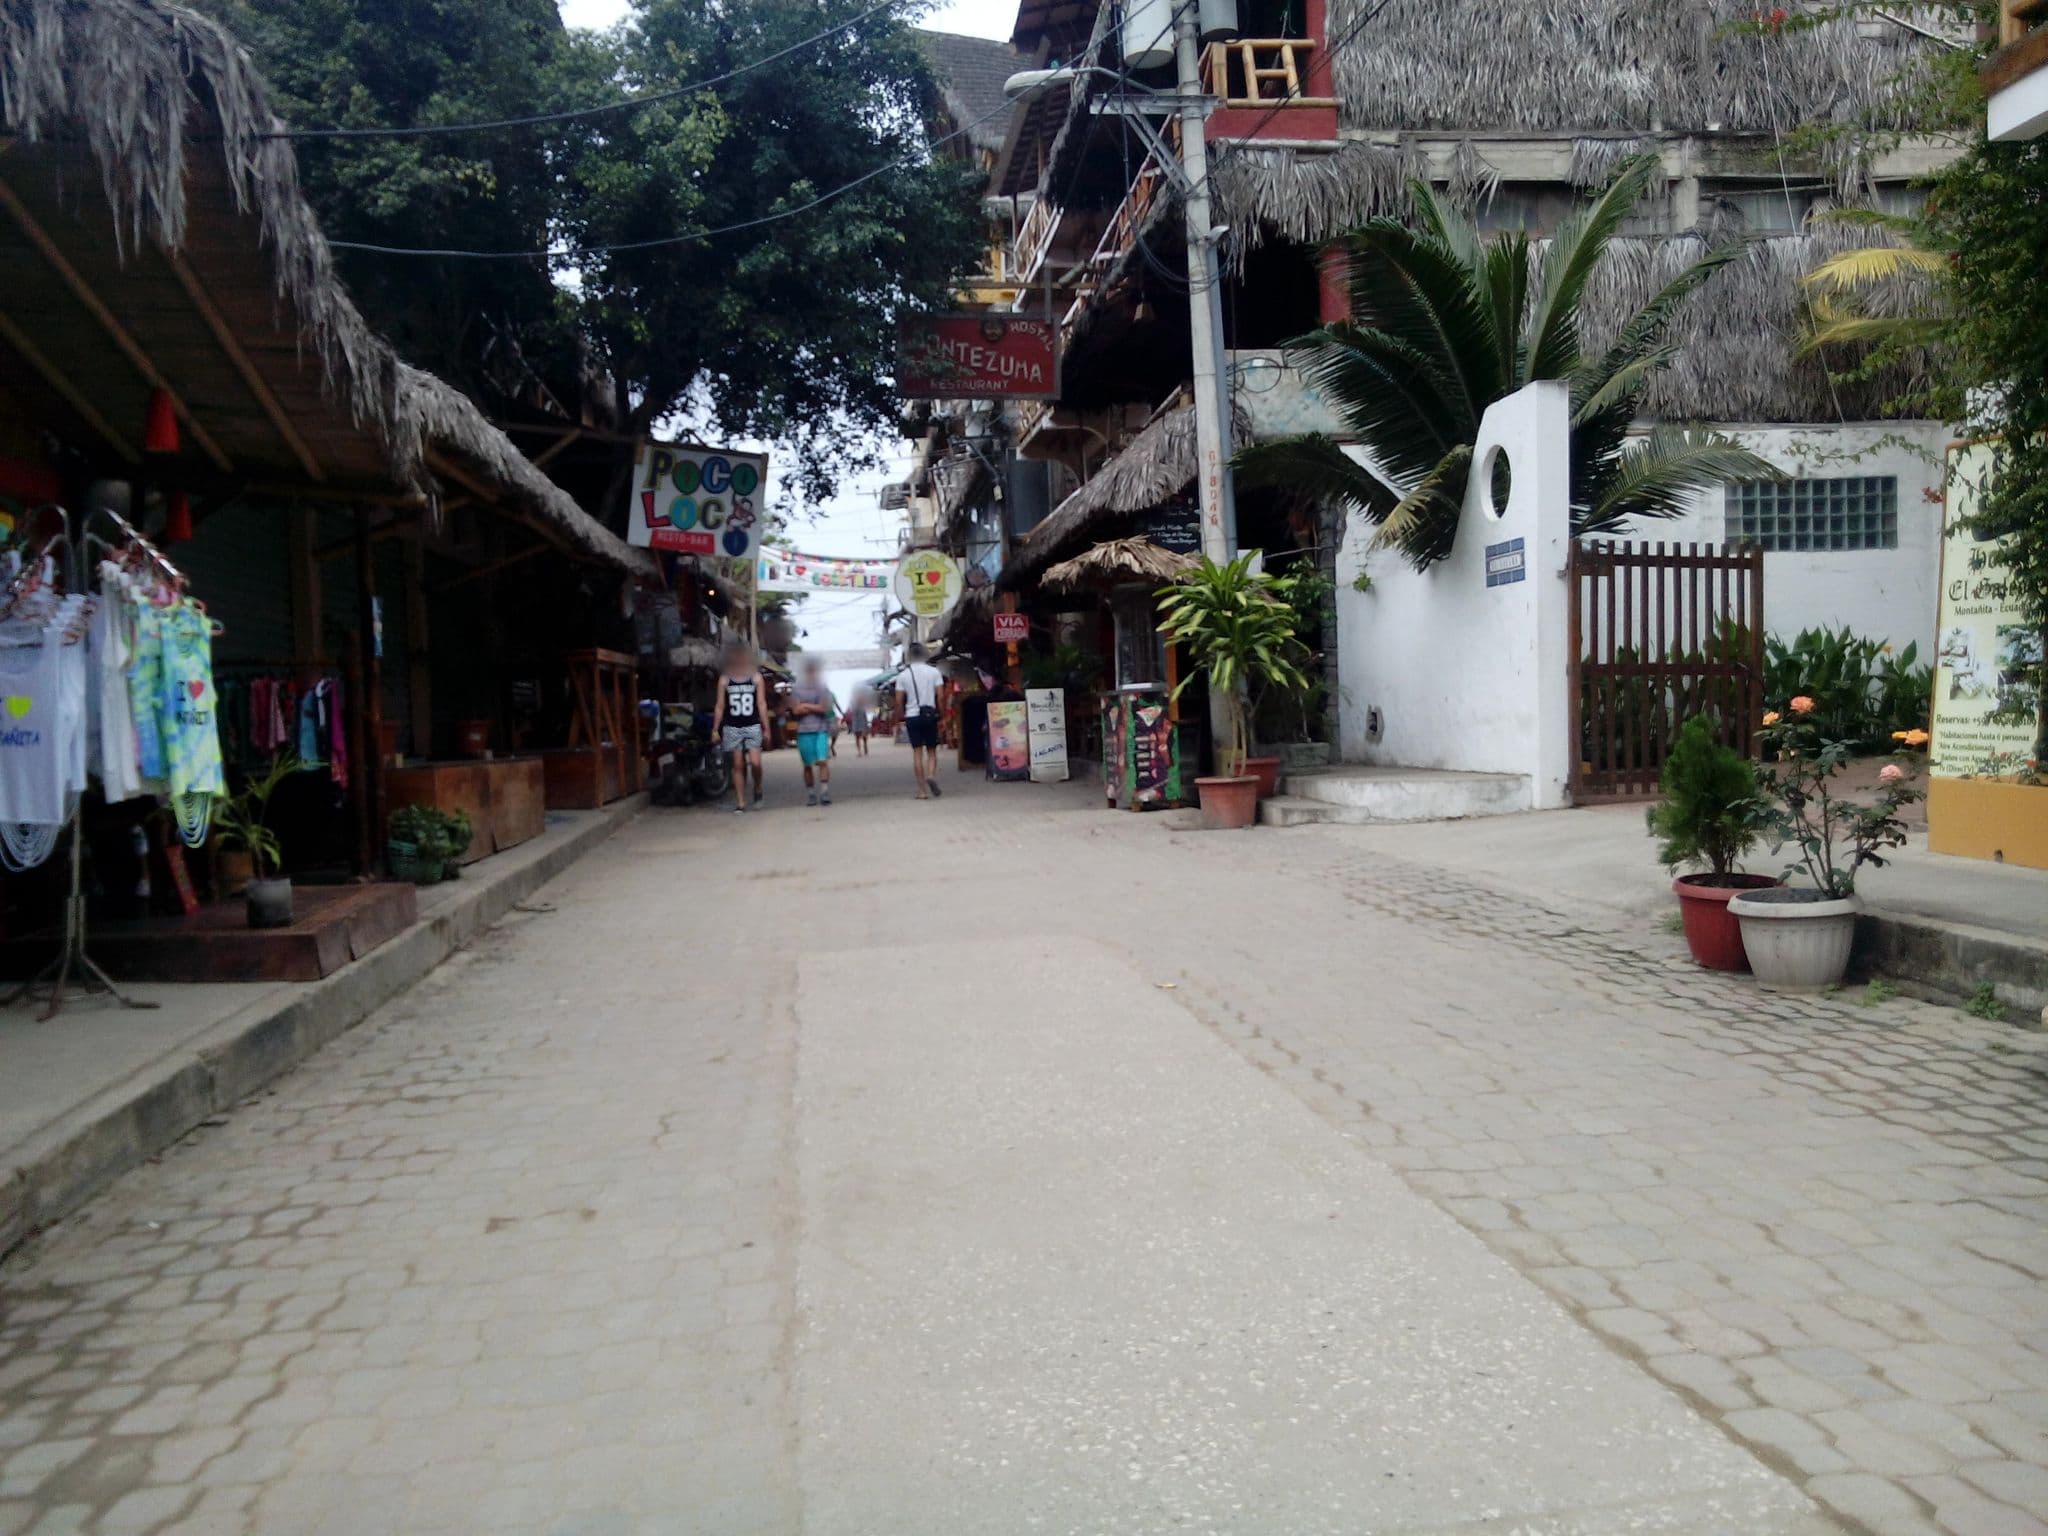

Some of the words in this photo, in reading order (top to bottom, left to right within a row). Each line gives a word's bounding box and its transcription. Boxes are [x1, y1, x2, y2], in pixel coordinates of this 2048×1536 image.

[912, 331, 1042, 384] ONTEZUMA
[930, 378, 1009, 392] RESTAURANT
[643, 447, 758, 496] POCO
[914, 572, 925, 586] I
[1948, 579, 1968, 601] El
[1954, 604, 1993, 616] Montañita
[999, 617, 1025, 628] VIA
[729, 693, 754, 716] 58
